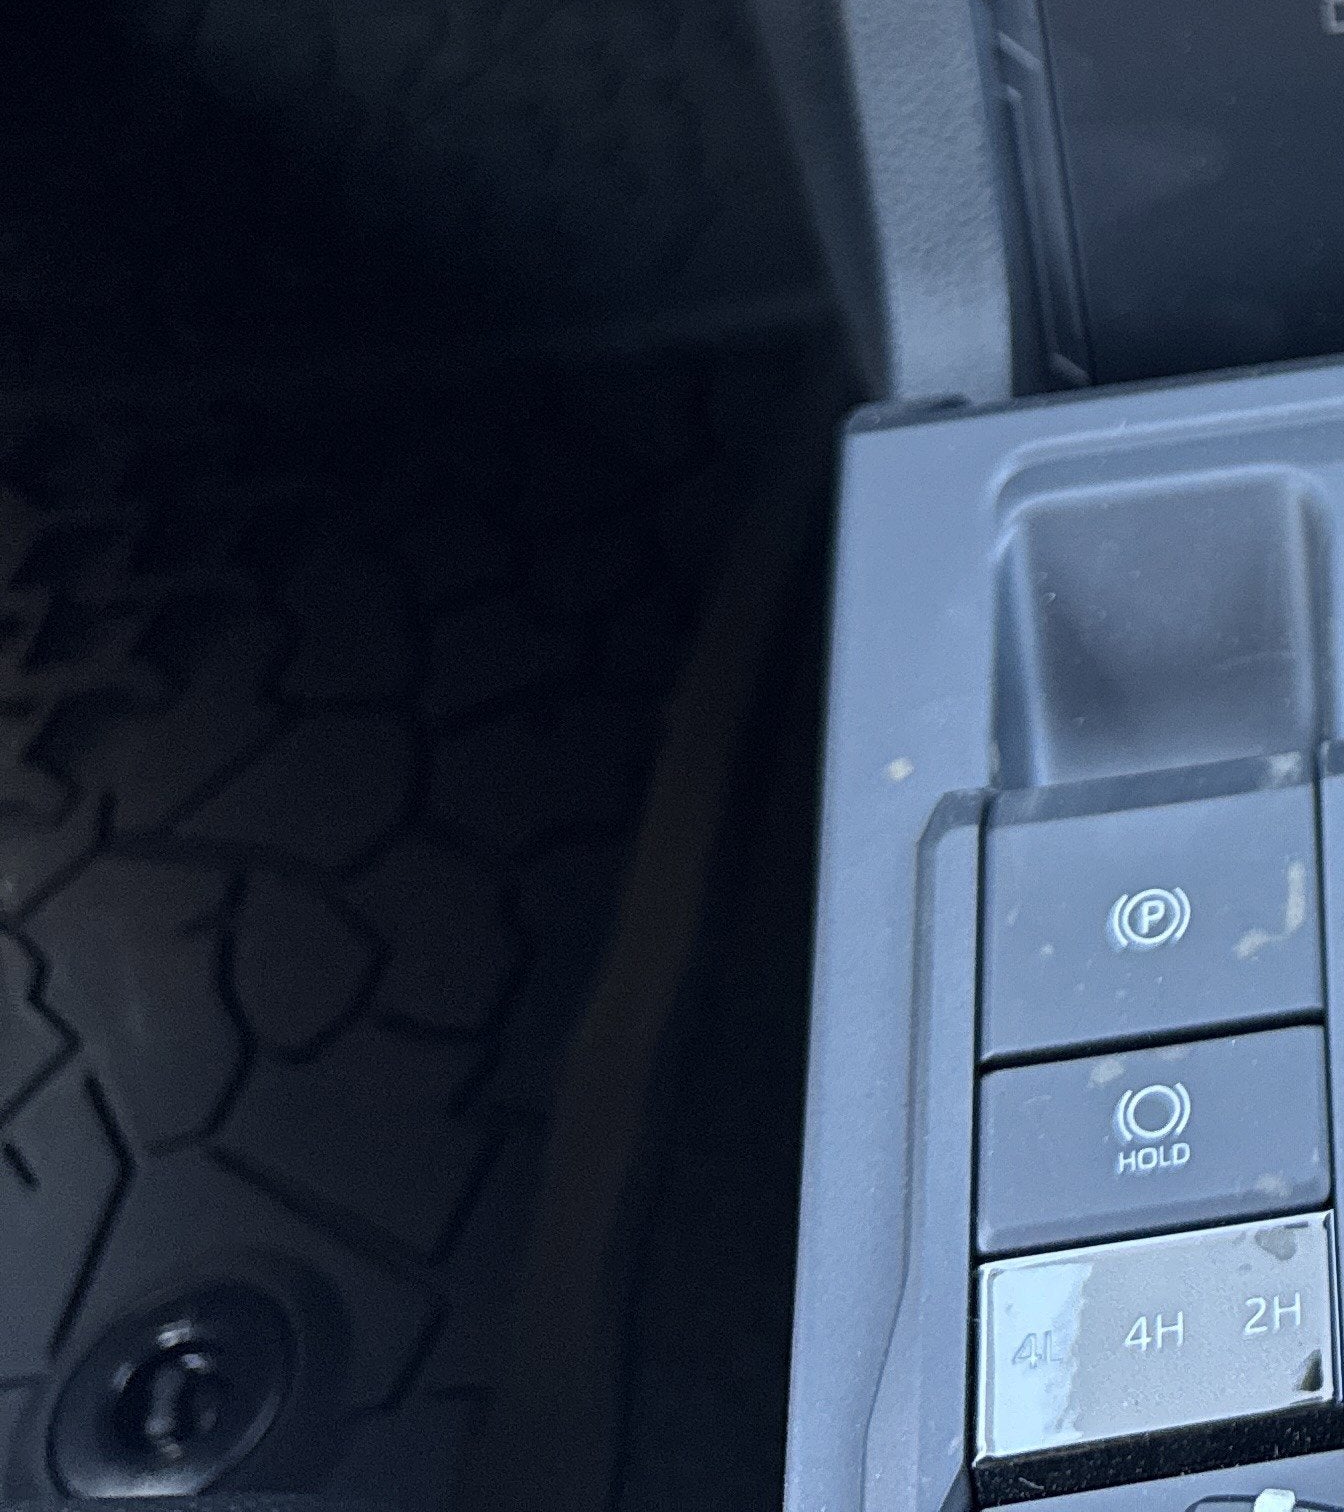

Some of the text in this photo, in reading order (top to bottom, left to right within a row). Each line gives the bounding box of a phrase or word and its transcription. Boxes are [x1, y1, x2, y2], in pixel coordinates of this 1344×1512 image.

[1139, 900, 1165, 934] P
[1116, 1143, 1191, 1174] HOLD
[1011, 1292, 1301, 1369] 4L 4H 2H
